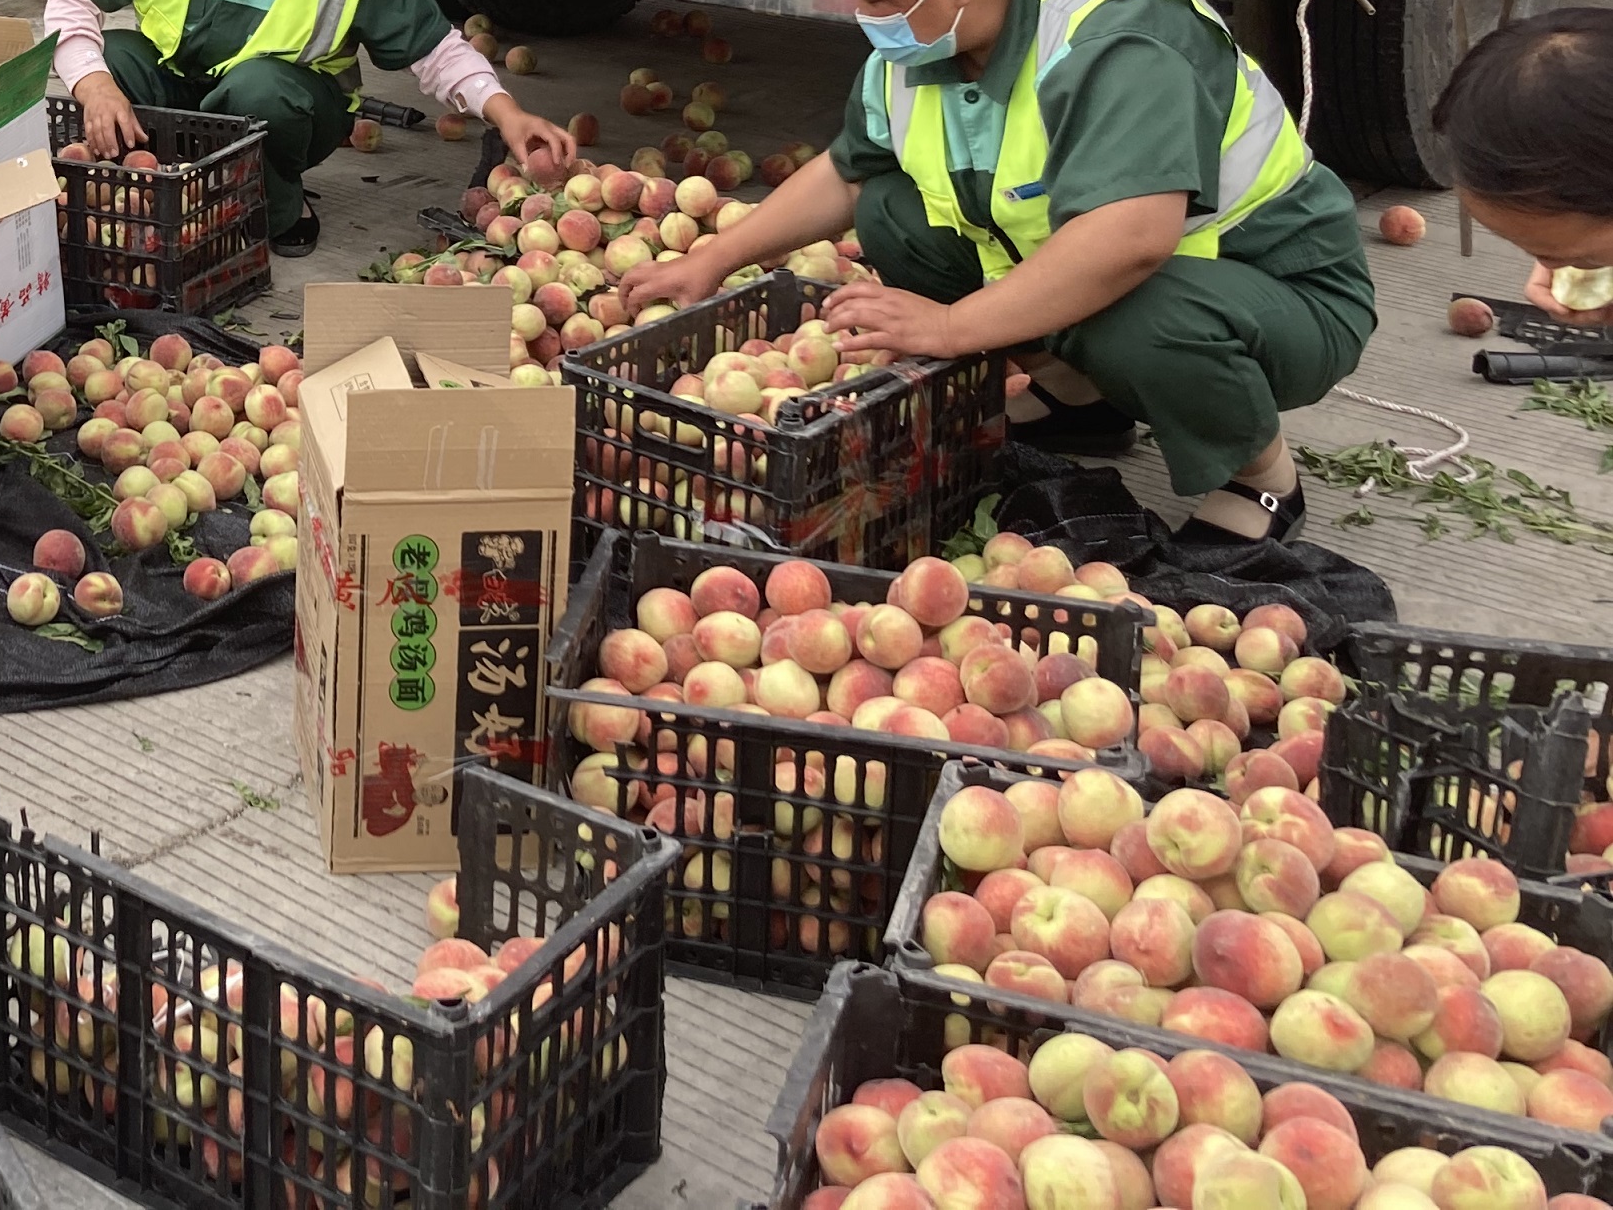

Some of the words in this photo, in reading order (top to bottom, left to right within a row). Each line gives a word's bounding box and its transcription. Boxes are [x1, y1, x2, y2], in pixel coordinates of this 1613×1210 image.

[395, 542, 432, 703] 老母鸡汤面
